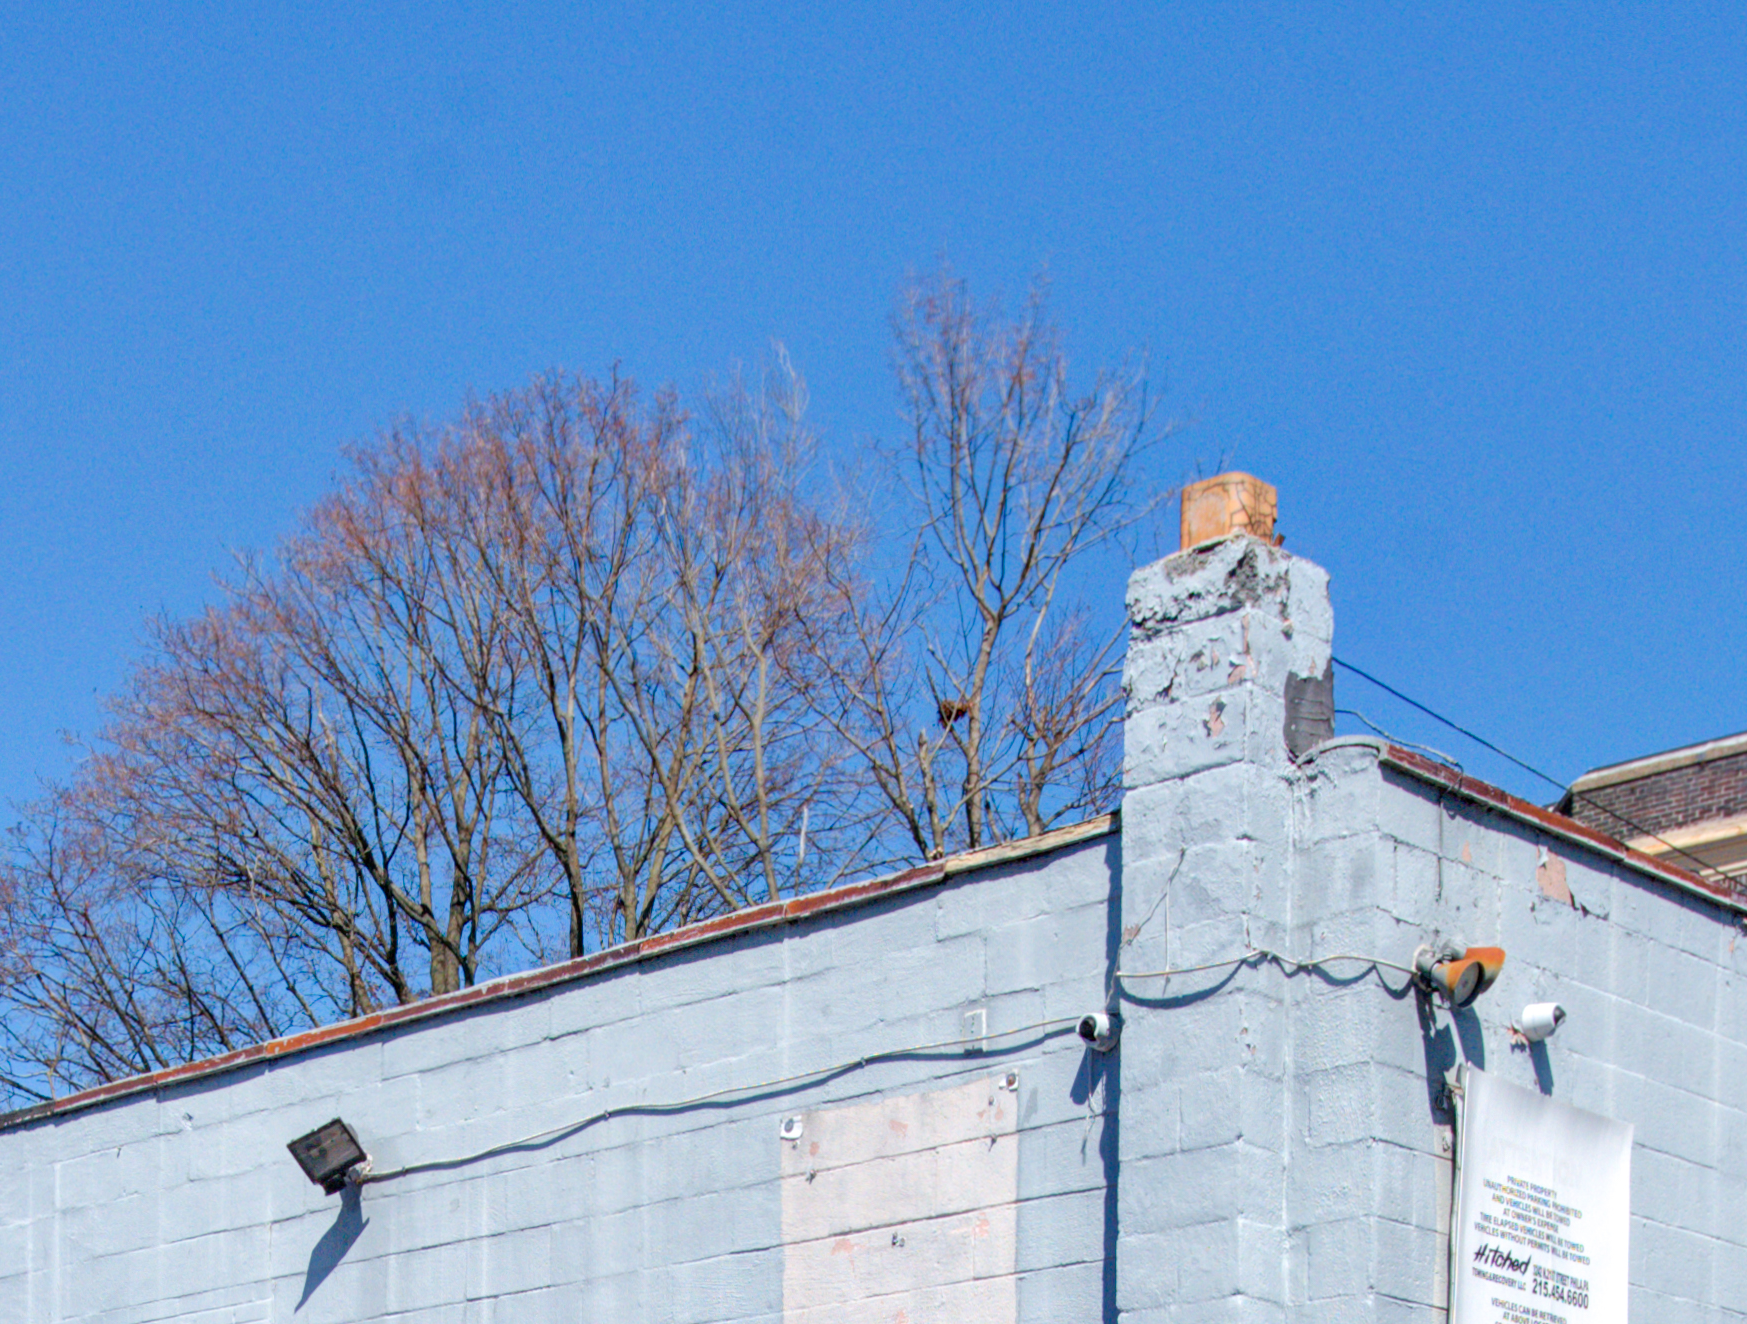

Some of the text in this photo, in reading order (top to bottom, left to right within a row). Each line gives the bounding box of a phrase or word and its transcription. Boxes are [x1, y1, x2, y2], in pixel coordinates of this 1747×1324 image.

[1483, 1178, 1581, 1218] UNAUTHORIZED PARKING PROHIBITED
[1507, 1176, 1556, 1199] PRIVATE PROPERTY
[1492, 1193, 1570, 1226] AND VEHICLES WILL BE TOWED
[1502, 1208, 1509, 1217] AT
[1537, 1219, 1558, 1233] EXPENSE
[1474, 1222, 1589, 1265] VEHICLES WITHOUT PERMITS WILL BE TOWED
[1480, 1212, 1583, 1252] TIME ELAPSED VEHICLES WILL BE TOWED
[1473, 1243, 1532, 1276] Hitched
[1517, 1281, 1525, 1291] LLC
[1532, 1279, 1588, 1309] 215.454.6600
[1492, 1298, 1517, 1312] VEHICLES
[1519, 1305, 1530, 1316] CAN
[1531, 1309, 1538, 1318] BE
[1502, 1312, 1510, 1321] AT
